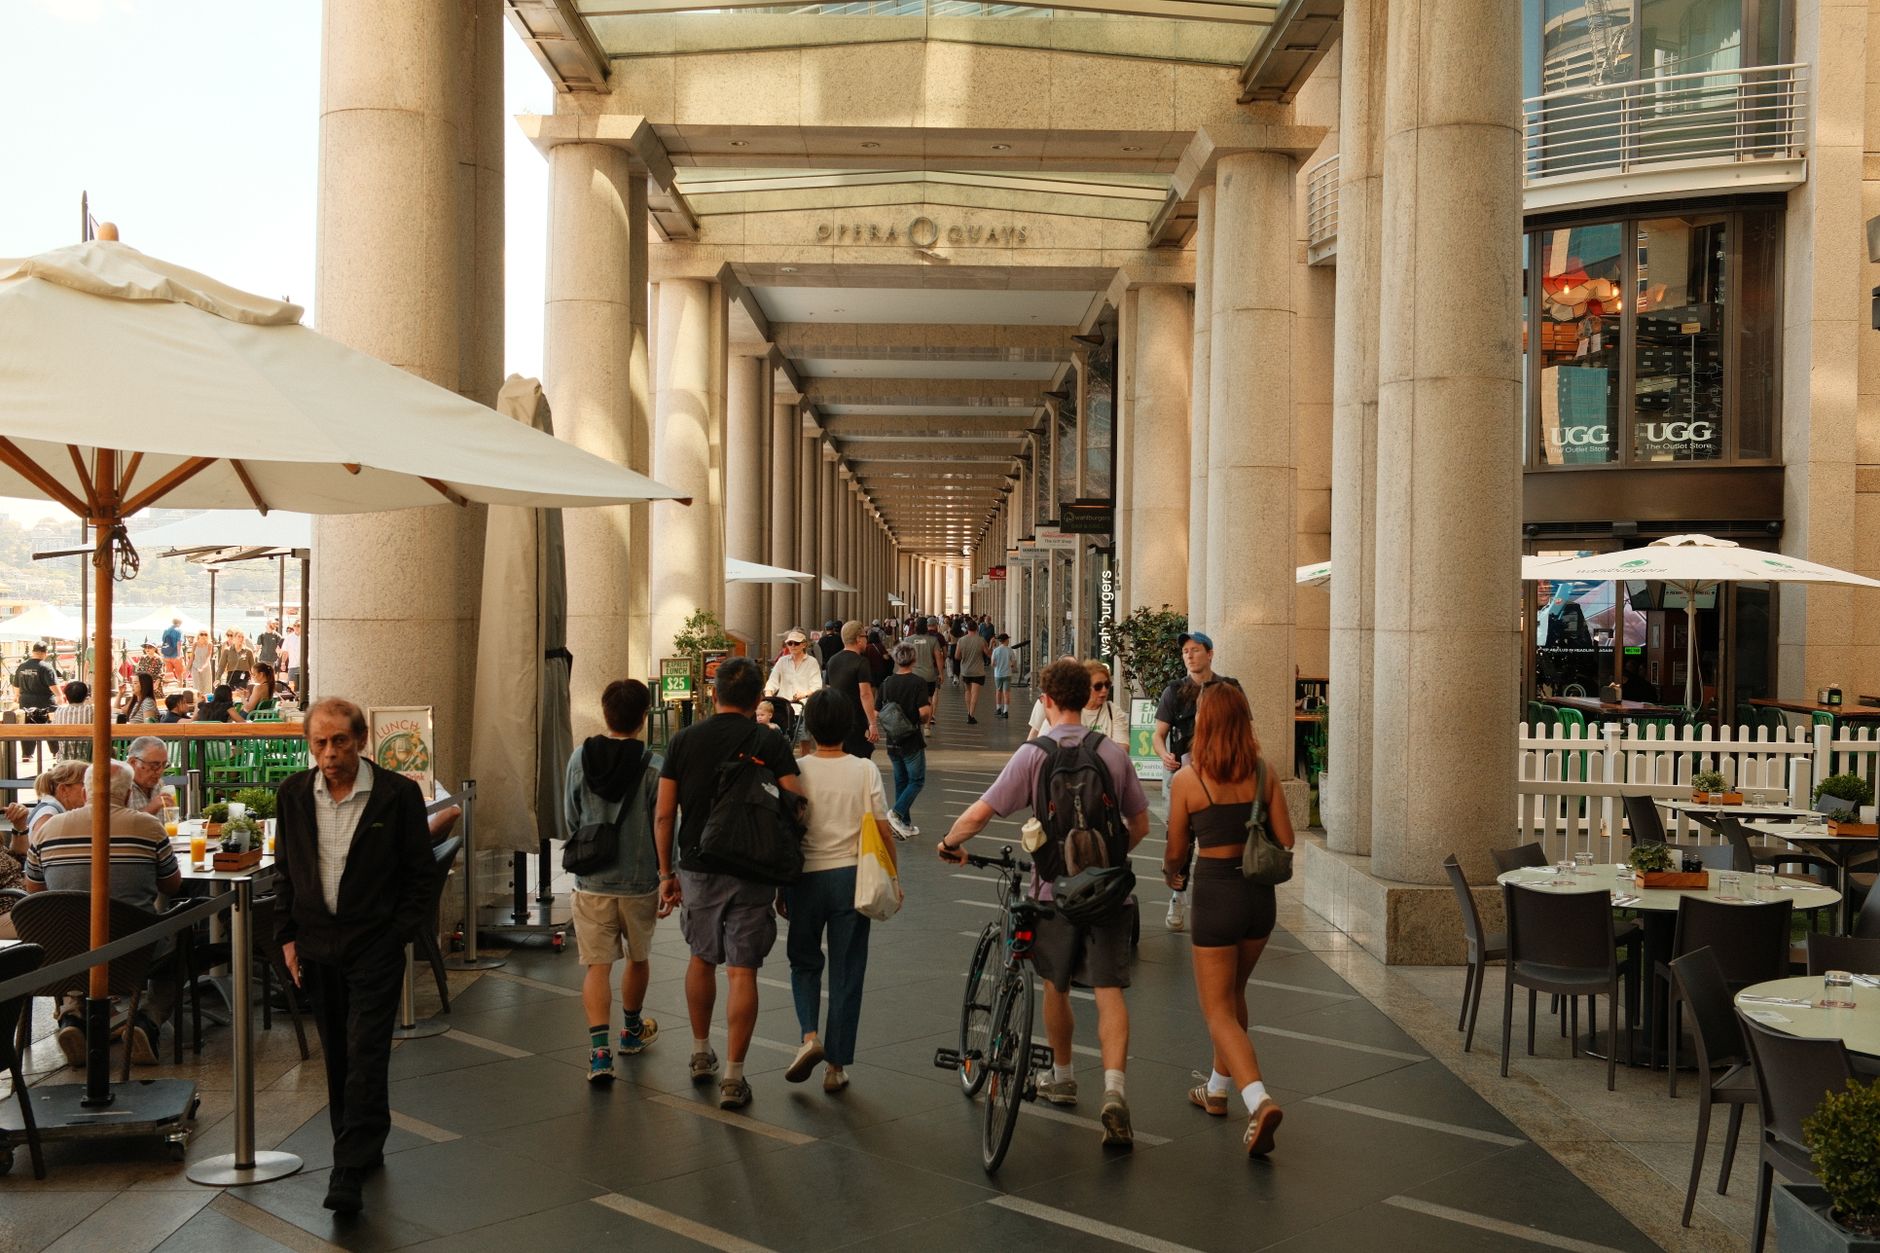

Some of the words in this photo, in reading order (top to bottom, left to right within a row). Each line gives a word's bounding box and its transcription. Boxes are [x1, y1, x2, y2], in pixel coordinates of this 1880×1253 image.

[815, 222, 900, 244] OPERA
[947, 224, 1029, 245] QUAYS
[1550, 425, 1610, 446] UGG
[1646, 421, 1712, 442] UGG
[1565, 446, 1588, 454] Outlet
[1589, 445, 1610, 453] Store
[1662, 442, 1688, 450] Outlet
[667, 677, 685, 690] $25
[376, 719, 420, 739] LUNCH
